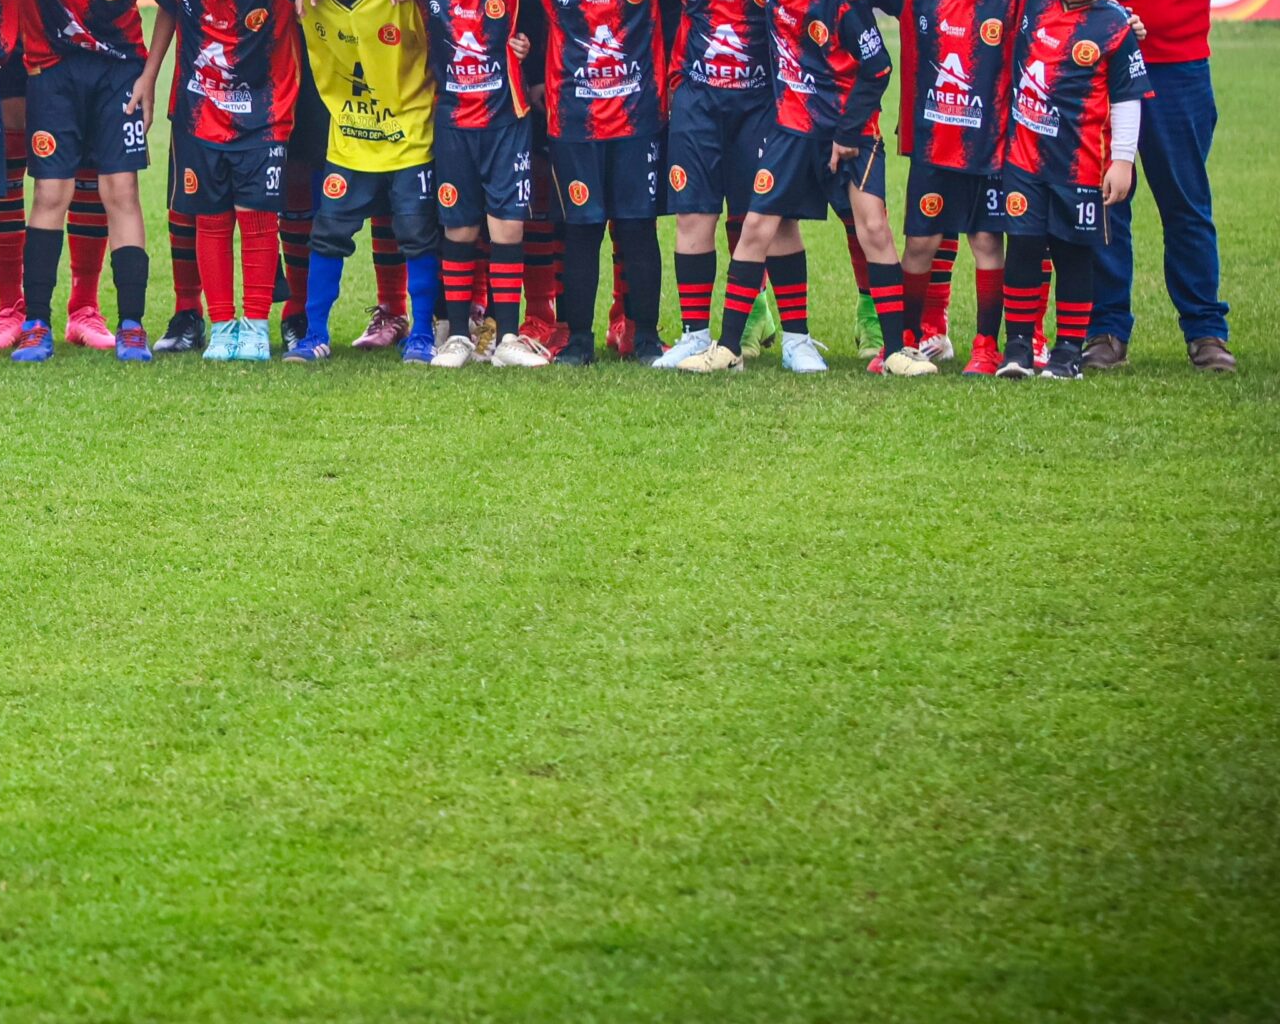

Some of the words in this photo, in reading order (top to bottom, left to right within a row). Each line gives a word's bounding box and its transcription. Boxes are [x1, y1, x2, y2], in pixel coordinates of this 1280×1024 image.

[446, 62, 501, 75] ARENA
[574, 61, 640, 78] ARENA
[693, 60, 766, 79] ARENA
[927, 88, 983, 108] ARENA
[926, 111, 944, 121] CENTRO
[945, 115, 978, 125] DEPORTIVO
[123, 120, 144, 146] 39
[516, 179, 531, 201] 18
[1076, 201, 1097, 225] 19
